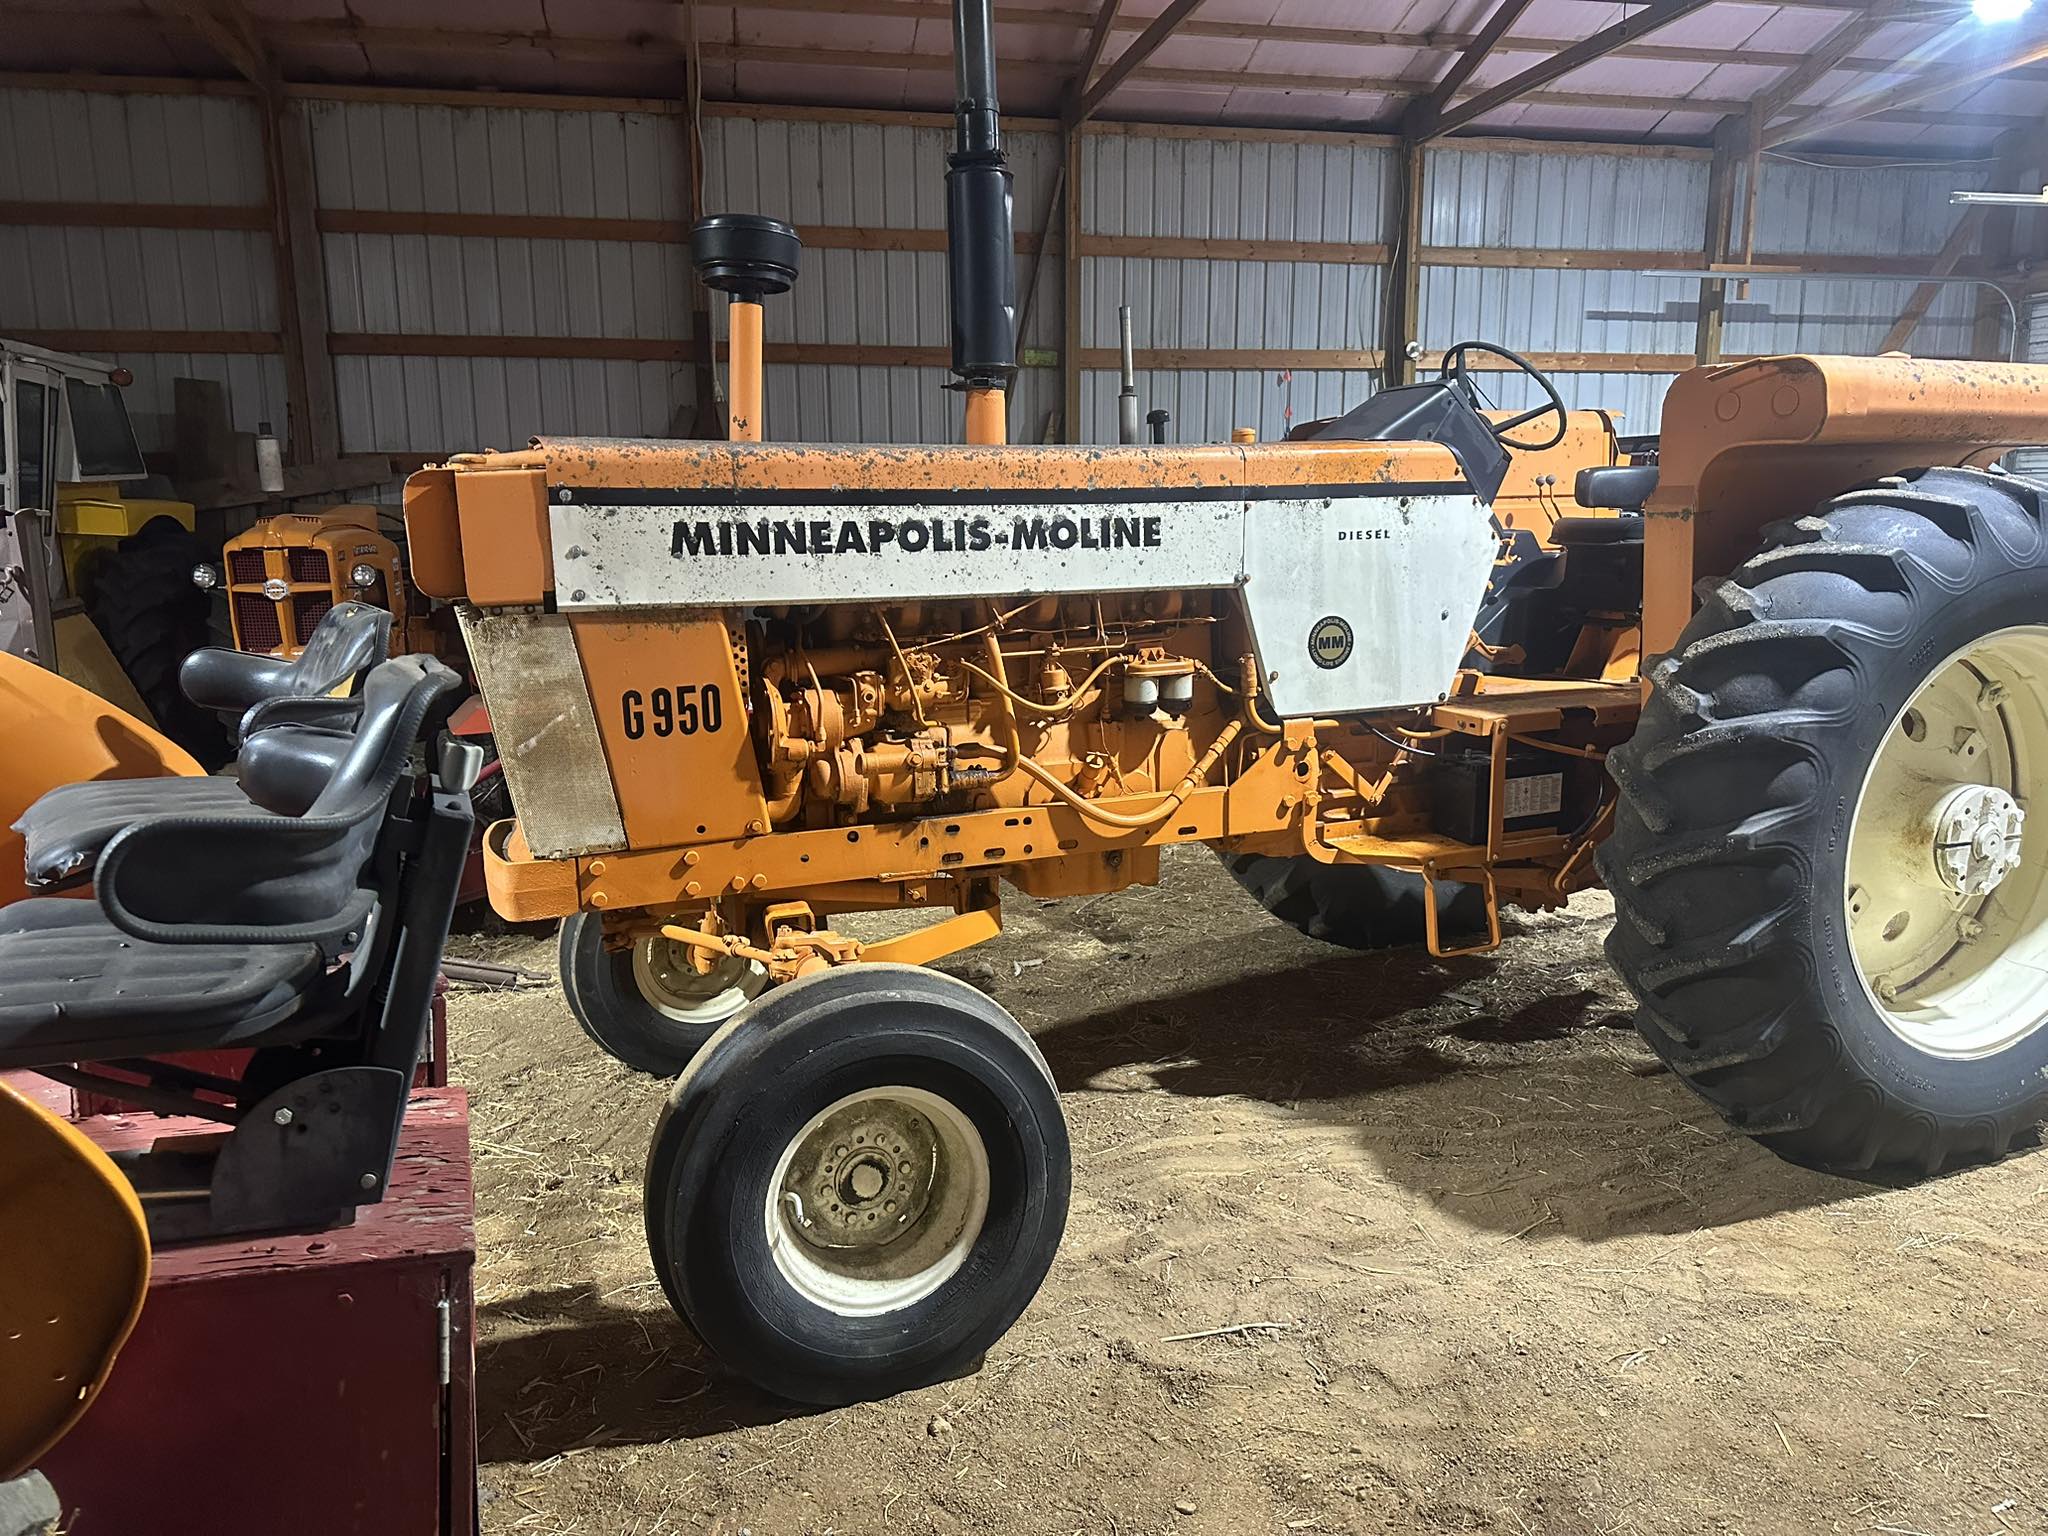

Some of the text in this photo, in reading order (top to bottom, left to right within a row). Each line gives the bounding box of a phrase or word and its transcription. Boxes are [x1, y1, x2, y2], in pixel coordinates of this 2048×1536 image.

[672, 516, 1162, 558] MINNEAPOLIS-MOLINE
[1338, 529, 1391, 541] DIESEL
[1318, 635, 1344, 650] MM
